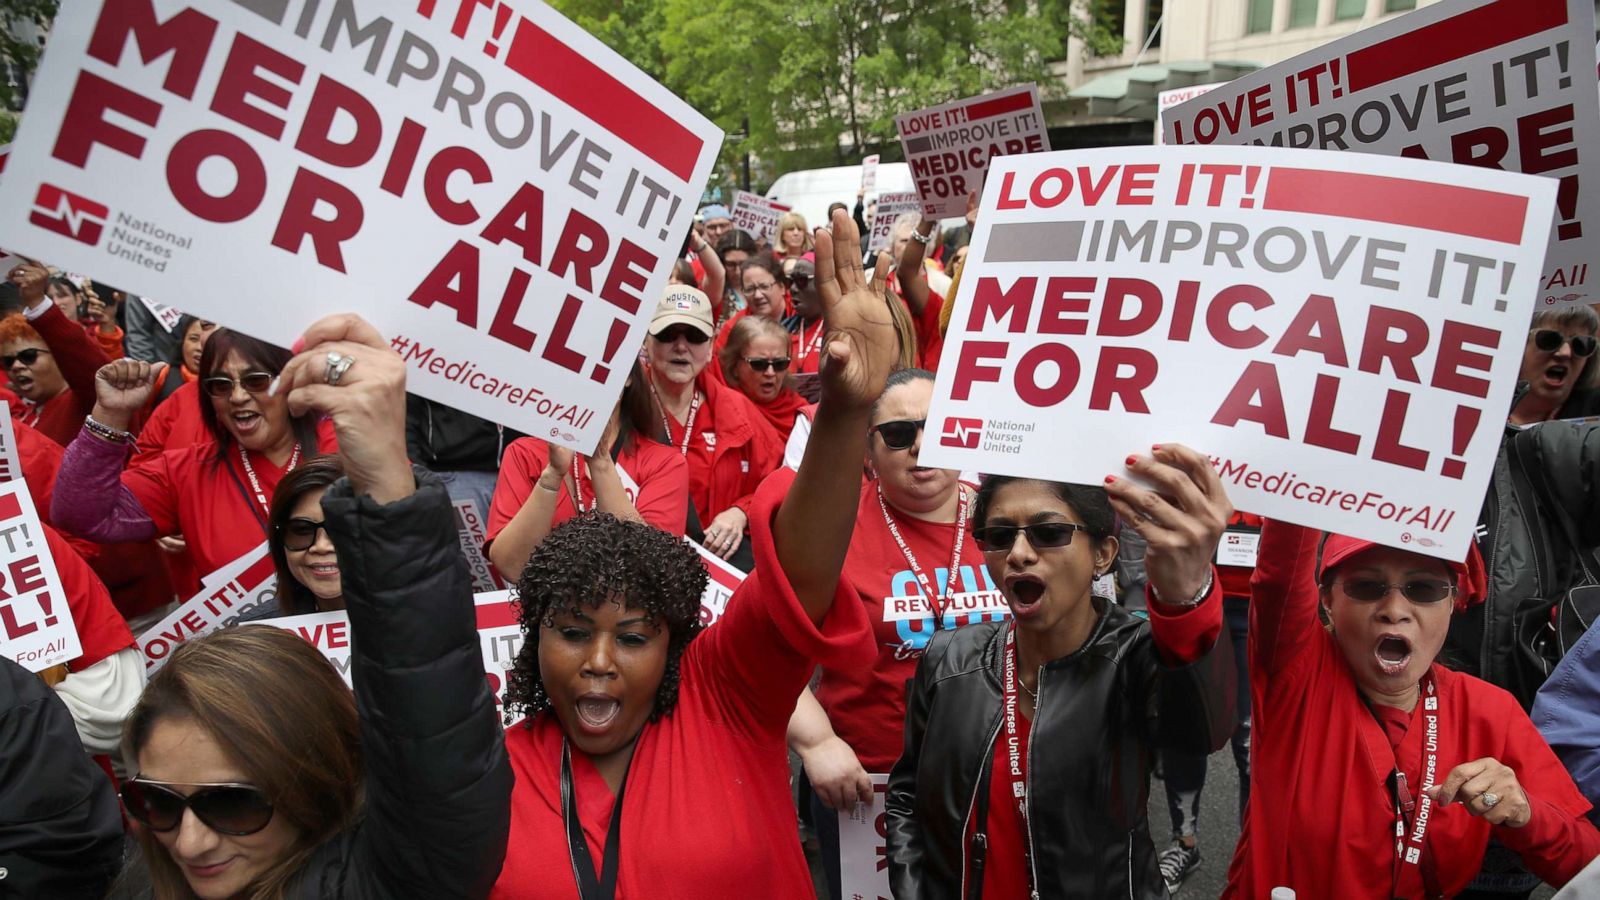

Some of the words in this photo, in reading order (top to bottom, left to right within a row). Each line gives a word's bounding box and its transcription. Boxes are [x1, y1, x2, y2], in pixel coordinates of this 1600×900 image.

[1241, 72, 1471, 151] MPROVE
[1492, 40, 1572, 109] IT!
[1285, 57, 1344, 114] IT!
[295, 0, 612, 200] IMPROVE
[616, 168, 682, 242] IT!
[901, 113, 942, 135] LOVE
[945, 107, 967, 127] IT!
[931, 119, 1010, 150] IMPROVE
[1014, 112, 1039, 133] IT!
[87, 0, 659, 316] MEDICARE
[917, 174, 968, 200] FOR
[996, 164, 1160, 211] LOVE
[1174, 163, 1262, 210] IT!
[52, 69, 364, 275] FOR
[408, 240, 632, 385] ALL!
[111, 227, 172, 259] Nurses
[117, 212, 192, 250] National
[107, 241, 167, 273] United
[1086, 219, 1415, 291] IMPROVE
[1426, 249, 1517, 313] IT!
[666, 293, 701, 305] HOUSTON
[966, 276, 1502, 400] MEDICARE
[391, 335, 594, 430] #MedicareForAll
[949, 340, 1158, 415] FOR
[1210, 361, 1483, 481] ALL!
[988, 419, 1035, 432] National
[983, 442, 1020, 454] United
[986, 431, 1024, 443] Nurses
[461, 504, 485, 543] LOVE
[959, 504, 967, 528] United
[0, 523, 34, 553] T!
[890, 523, 906, 550] Nurses
[903, 546, 922, 572] United
[954, 526, 965, 555] Nurses
[458, 529, 496, 592] IMPROVE
[949, 553, 961, 585] National
[203, 581, 245, 617] IT!
[1006, 649, 1014, 693] National
[1006, 695, 1016, 734] Nurses
[1426, 715, 1438, 752] United
[1008, 736, 1022, 776] United
[1423, 754, 1437, 792] Nurses
[1412, 794, 1432, 842] National
